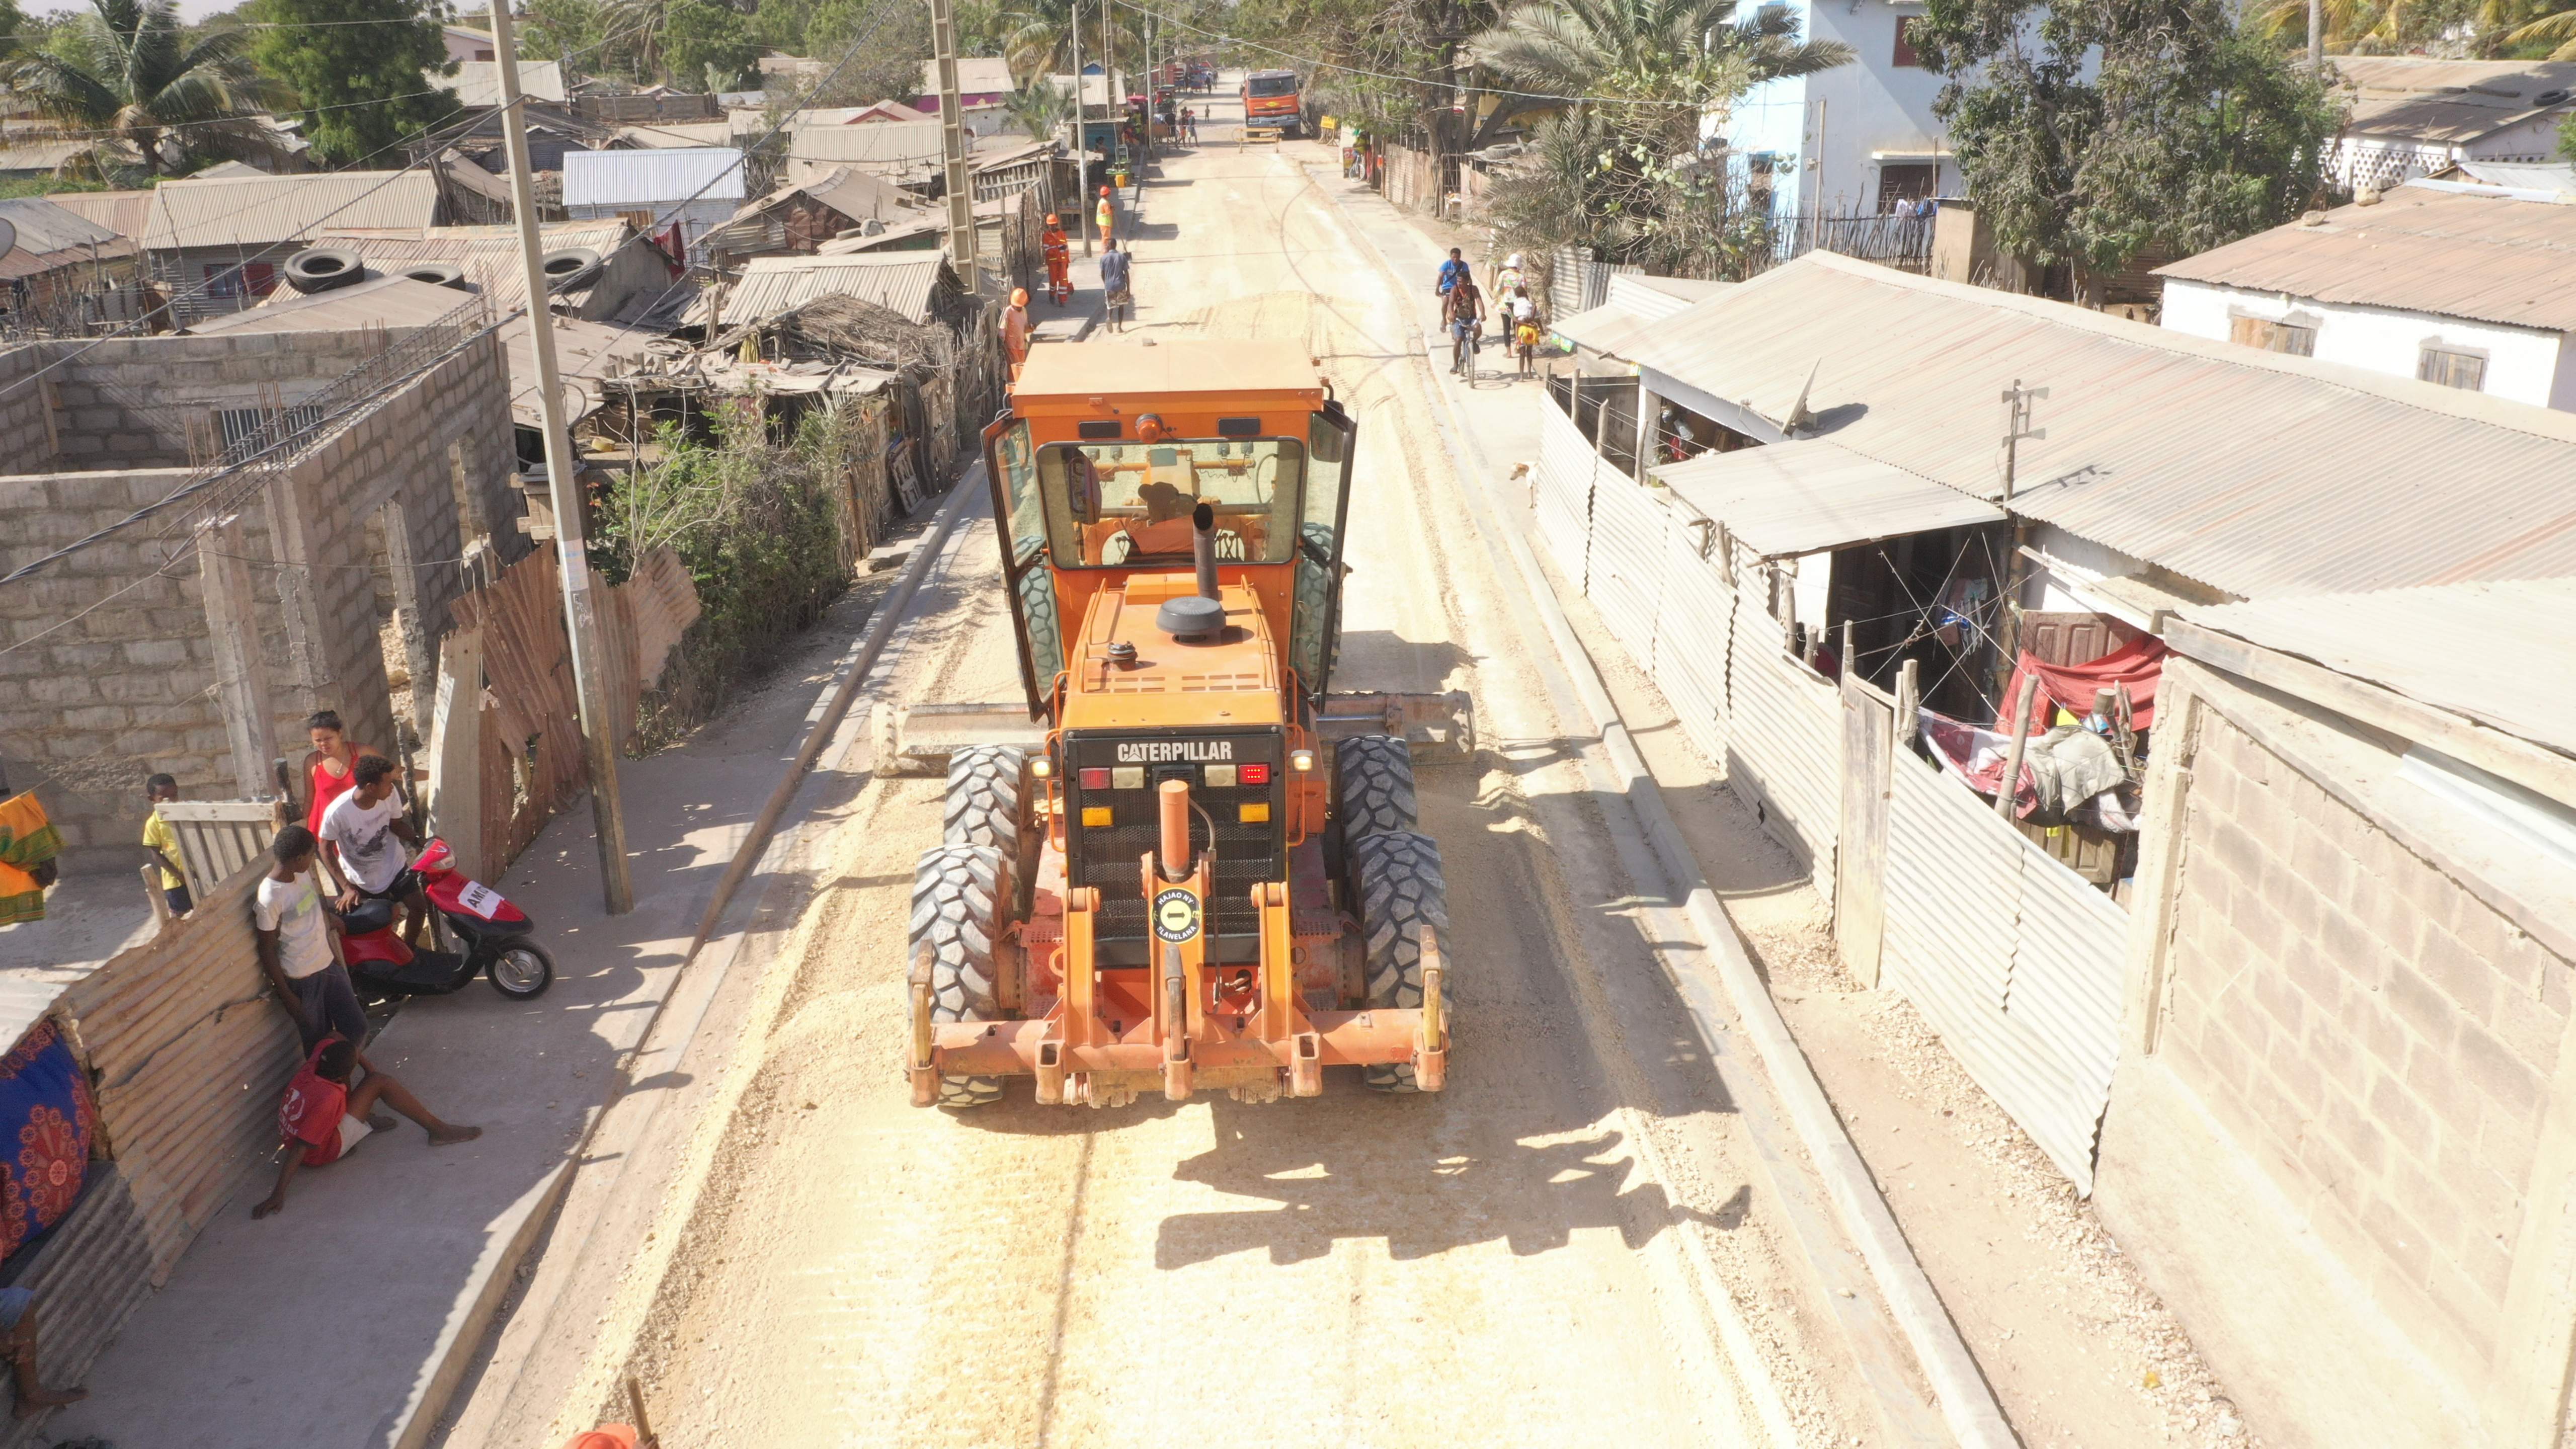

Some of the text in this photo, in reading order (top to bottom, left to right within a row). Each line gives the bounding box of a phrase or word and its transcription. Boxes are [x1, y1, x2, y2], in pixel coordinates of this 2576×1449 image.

[1117, 742, 1232, 762] CATERPILLAR
[1158, 892, 1194, 905] HAJAO NY
[1156, 925, 1197, 940] ELANELANA
